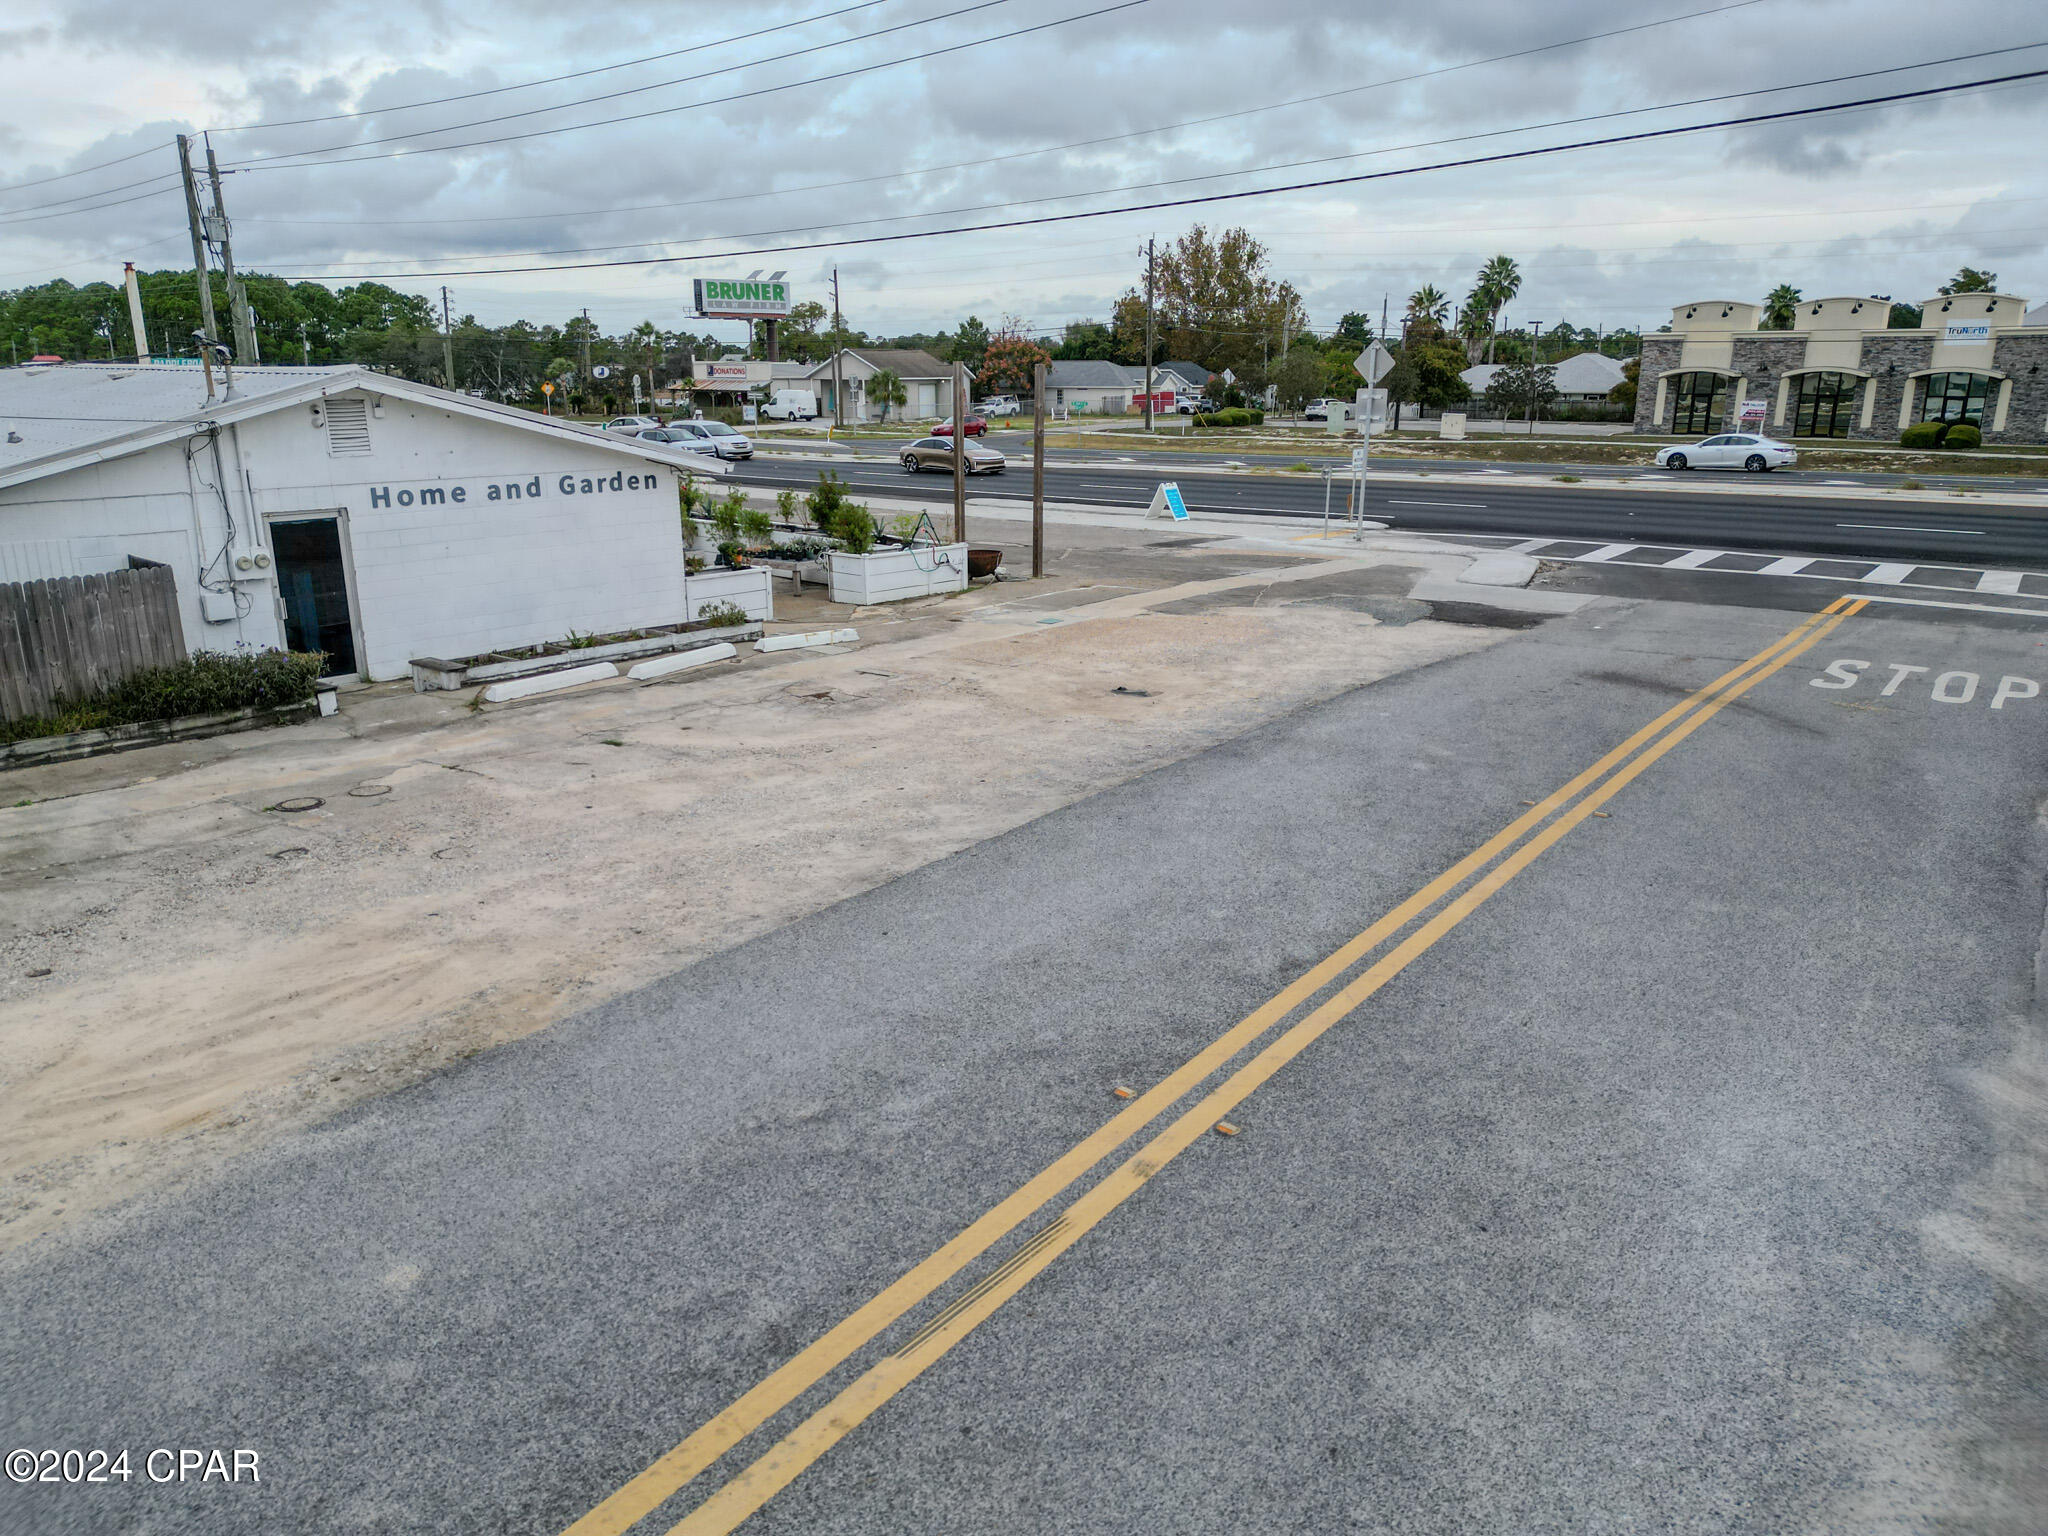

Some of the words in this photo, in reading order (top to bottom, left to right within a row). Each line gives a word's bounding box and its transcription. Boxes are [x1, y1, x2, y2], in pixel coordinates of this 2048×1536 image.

[706, 281, 785, 301] BRUNER
[713, 367, 746, 375] DONATIONS
[370, 485, 467, 509] Home
[487, 476, 542, 501] and
[558, 471, 658, 496] Garden
[1808, 659, 2040, 710] STOP
